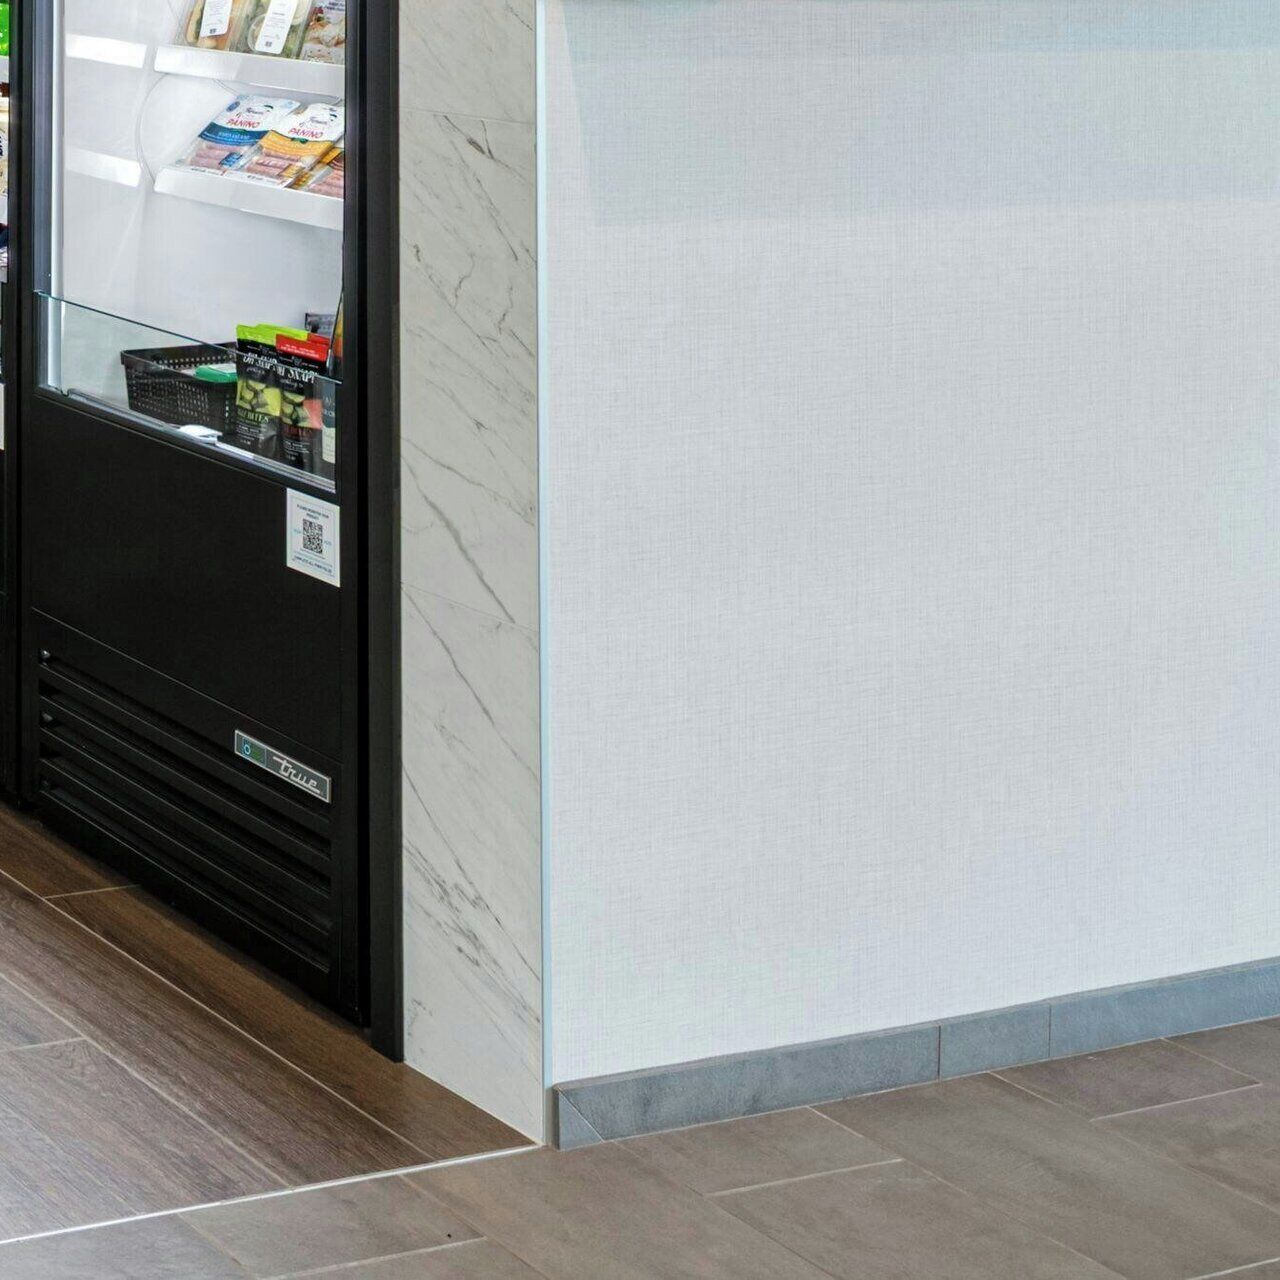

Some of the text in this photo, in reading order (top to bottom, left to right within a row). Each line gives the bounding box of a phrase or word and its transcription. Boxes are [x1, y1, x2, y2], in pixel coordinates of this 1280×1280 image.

[226, 117, 261, 129] PANINO
[287, 126, 324, 139] PANINO
[271, 755, 321, 795] true
